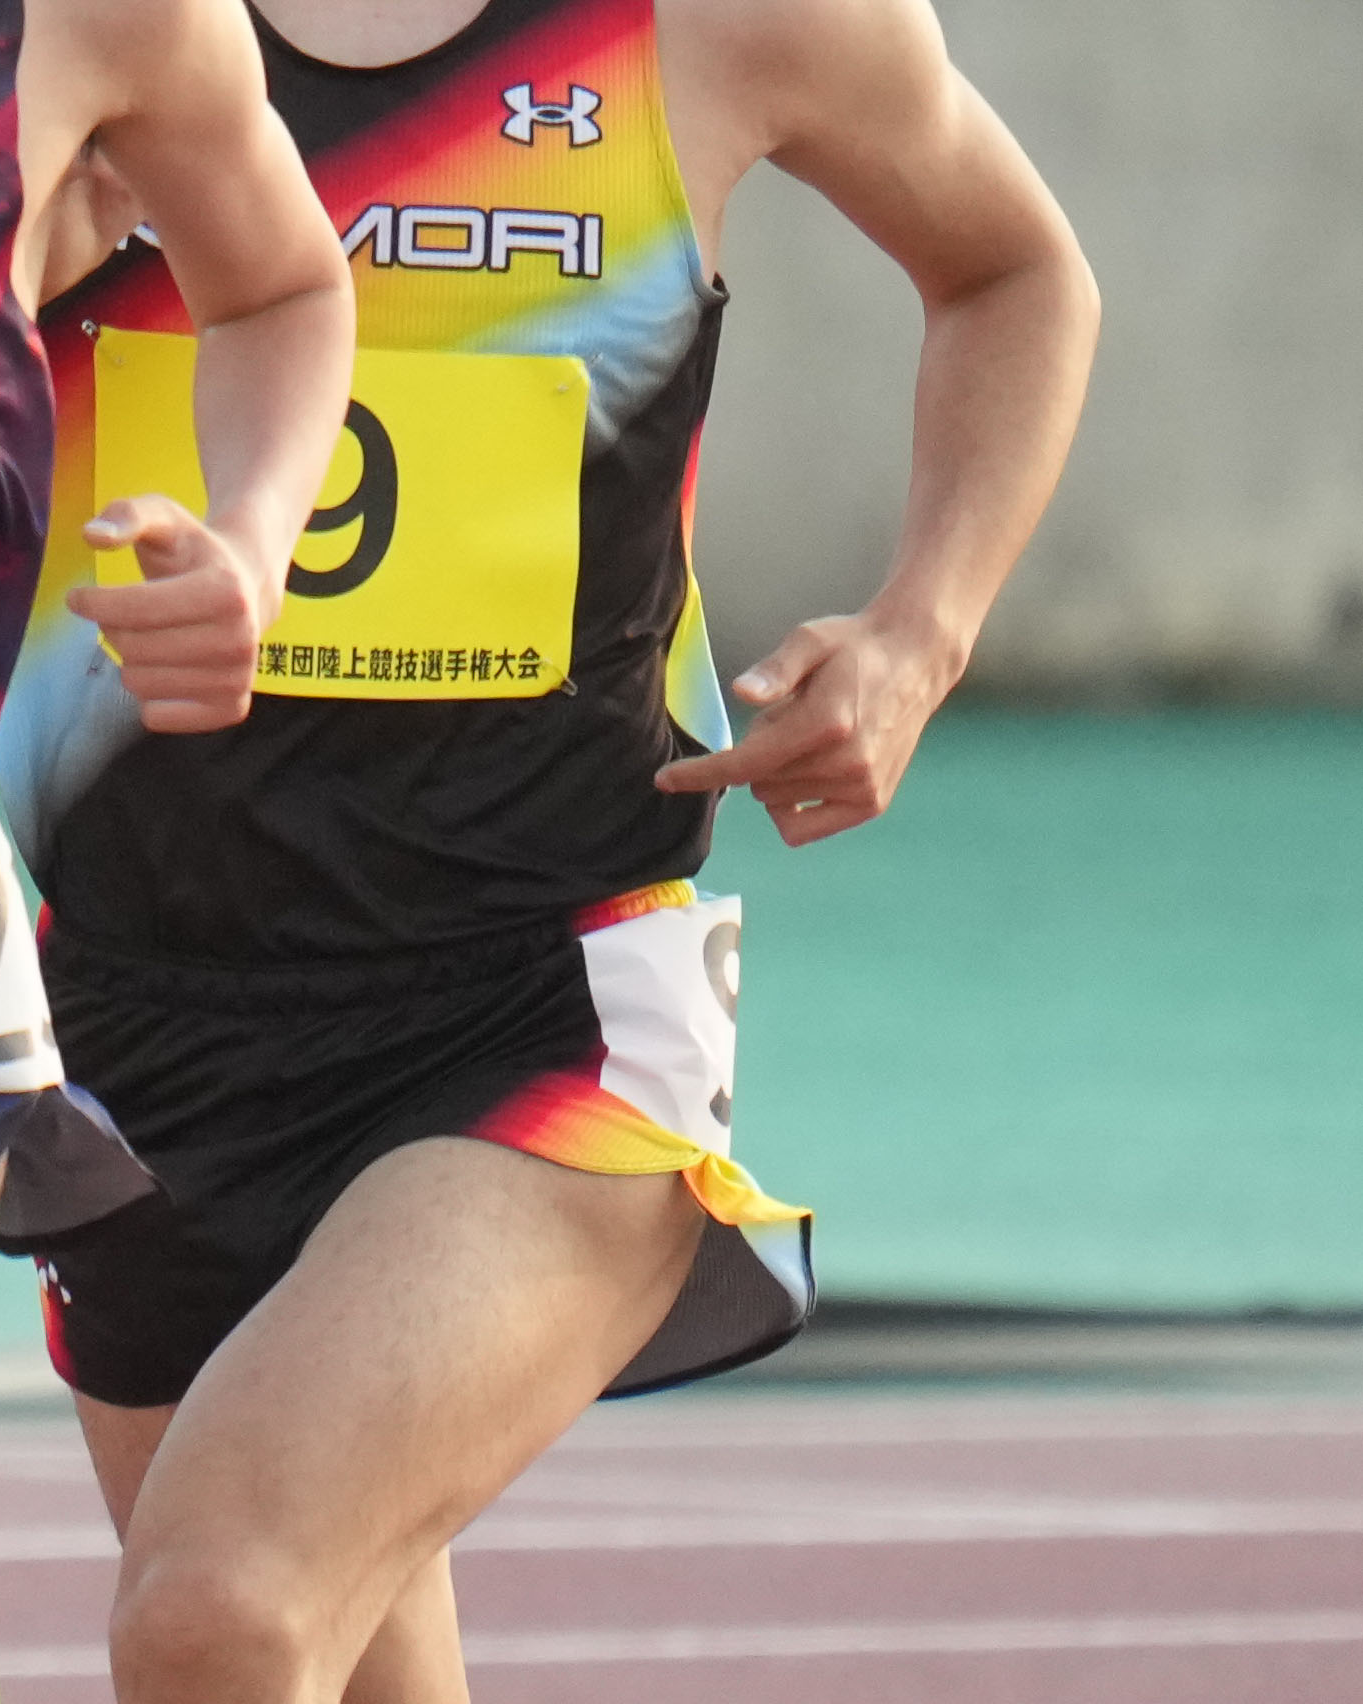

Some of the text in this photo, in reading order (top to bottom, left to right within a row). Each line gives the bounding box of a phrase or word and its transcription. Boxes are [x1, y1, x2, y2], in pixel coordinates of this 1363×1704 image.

[284, 397, 400, 600] 9
[256, 641, 542, 683] 業団陸上競技選手権大会
